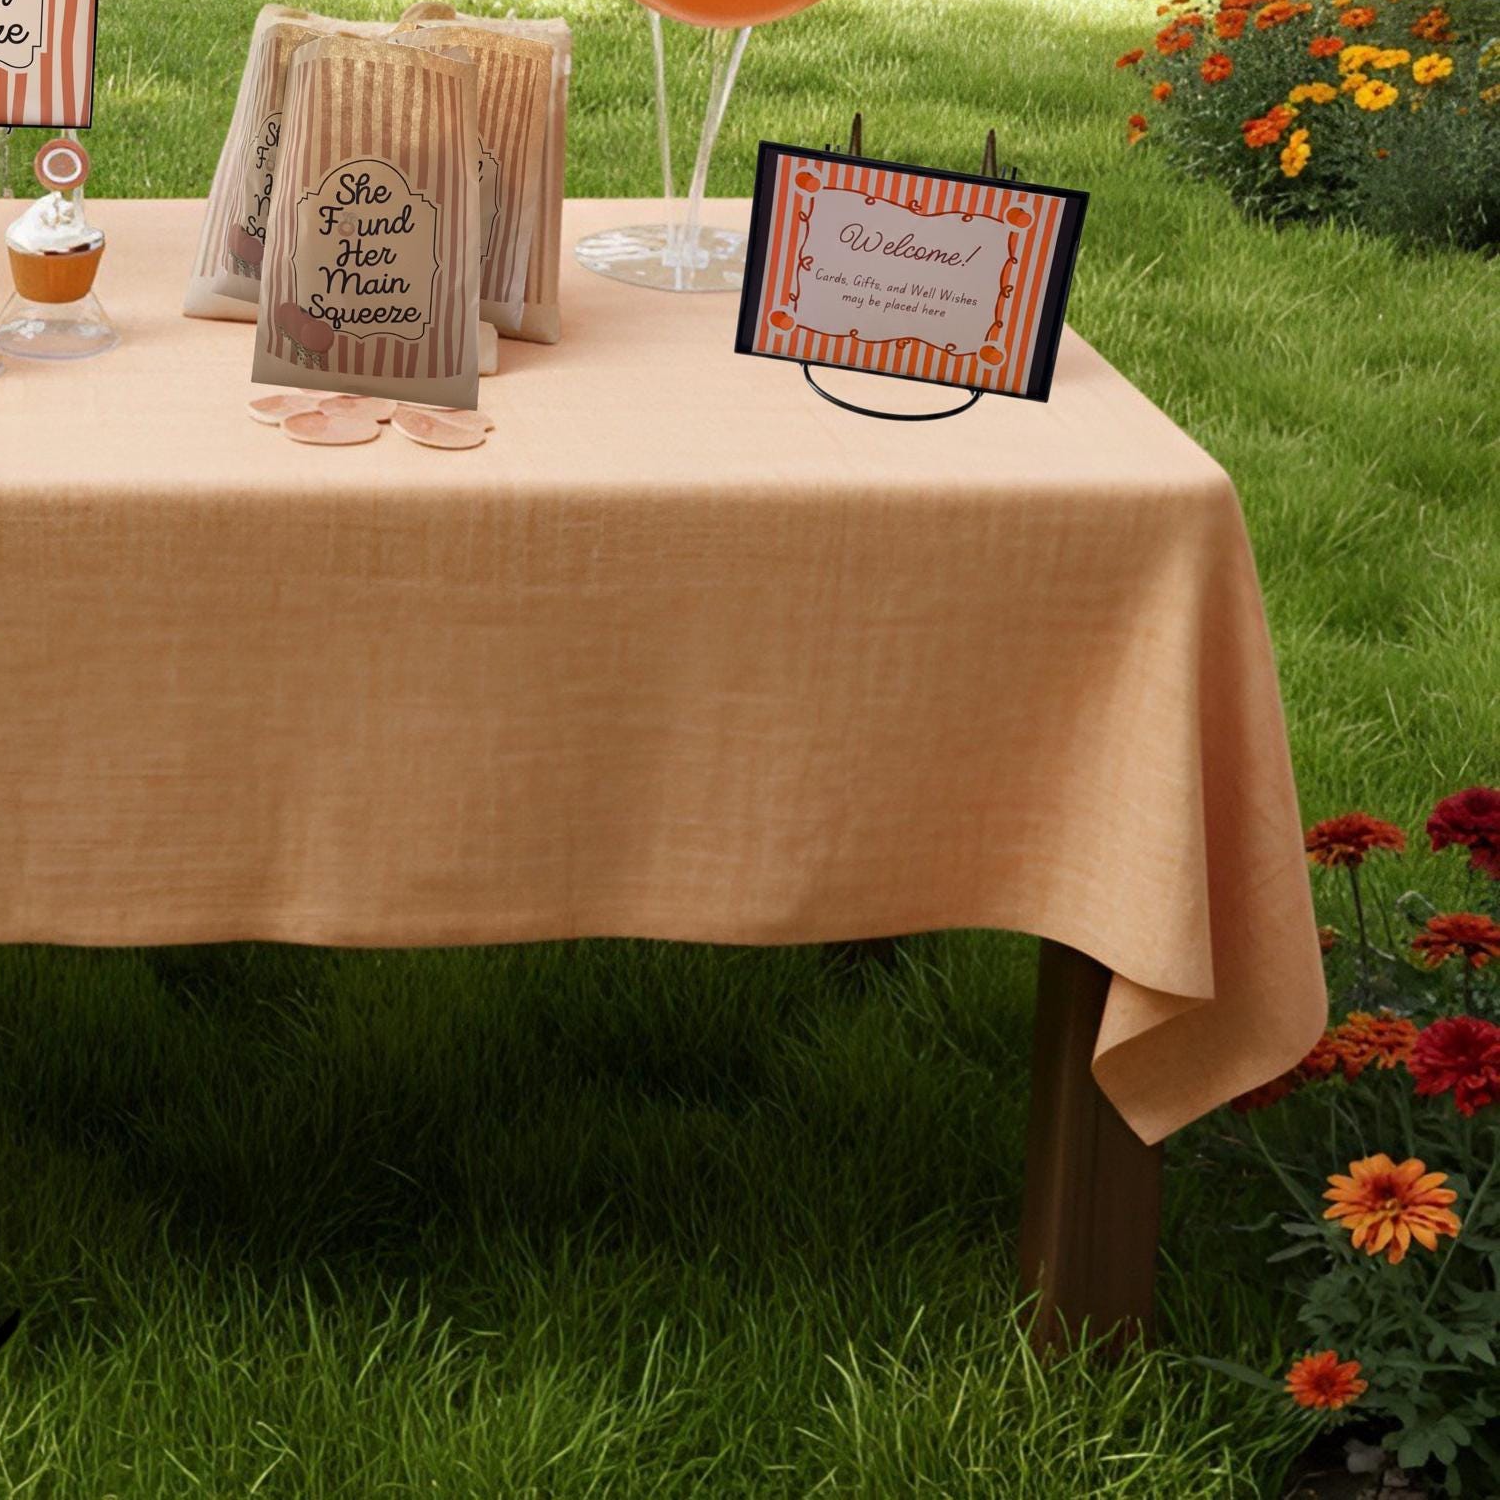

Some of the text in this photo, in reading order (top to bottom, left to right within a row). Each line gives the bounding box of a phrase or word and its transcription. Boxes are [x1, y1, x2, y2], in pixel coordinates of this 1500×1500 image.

[336, 173, 392, 205] She
[337, 239, 397, 267] Her
[839, 223, 982, 267] Welcome!
[319, 266, 410, 295] Main
[815, 268, 978, 306] Cards, Gifts, and Well Wishes
[309, 294, 421, 329] Squeeze
[842, 294, 946, 318] may be placed here
